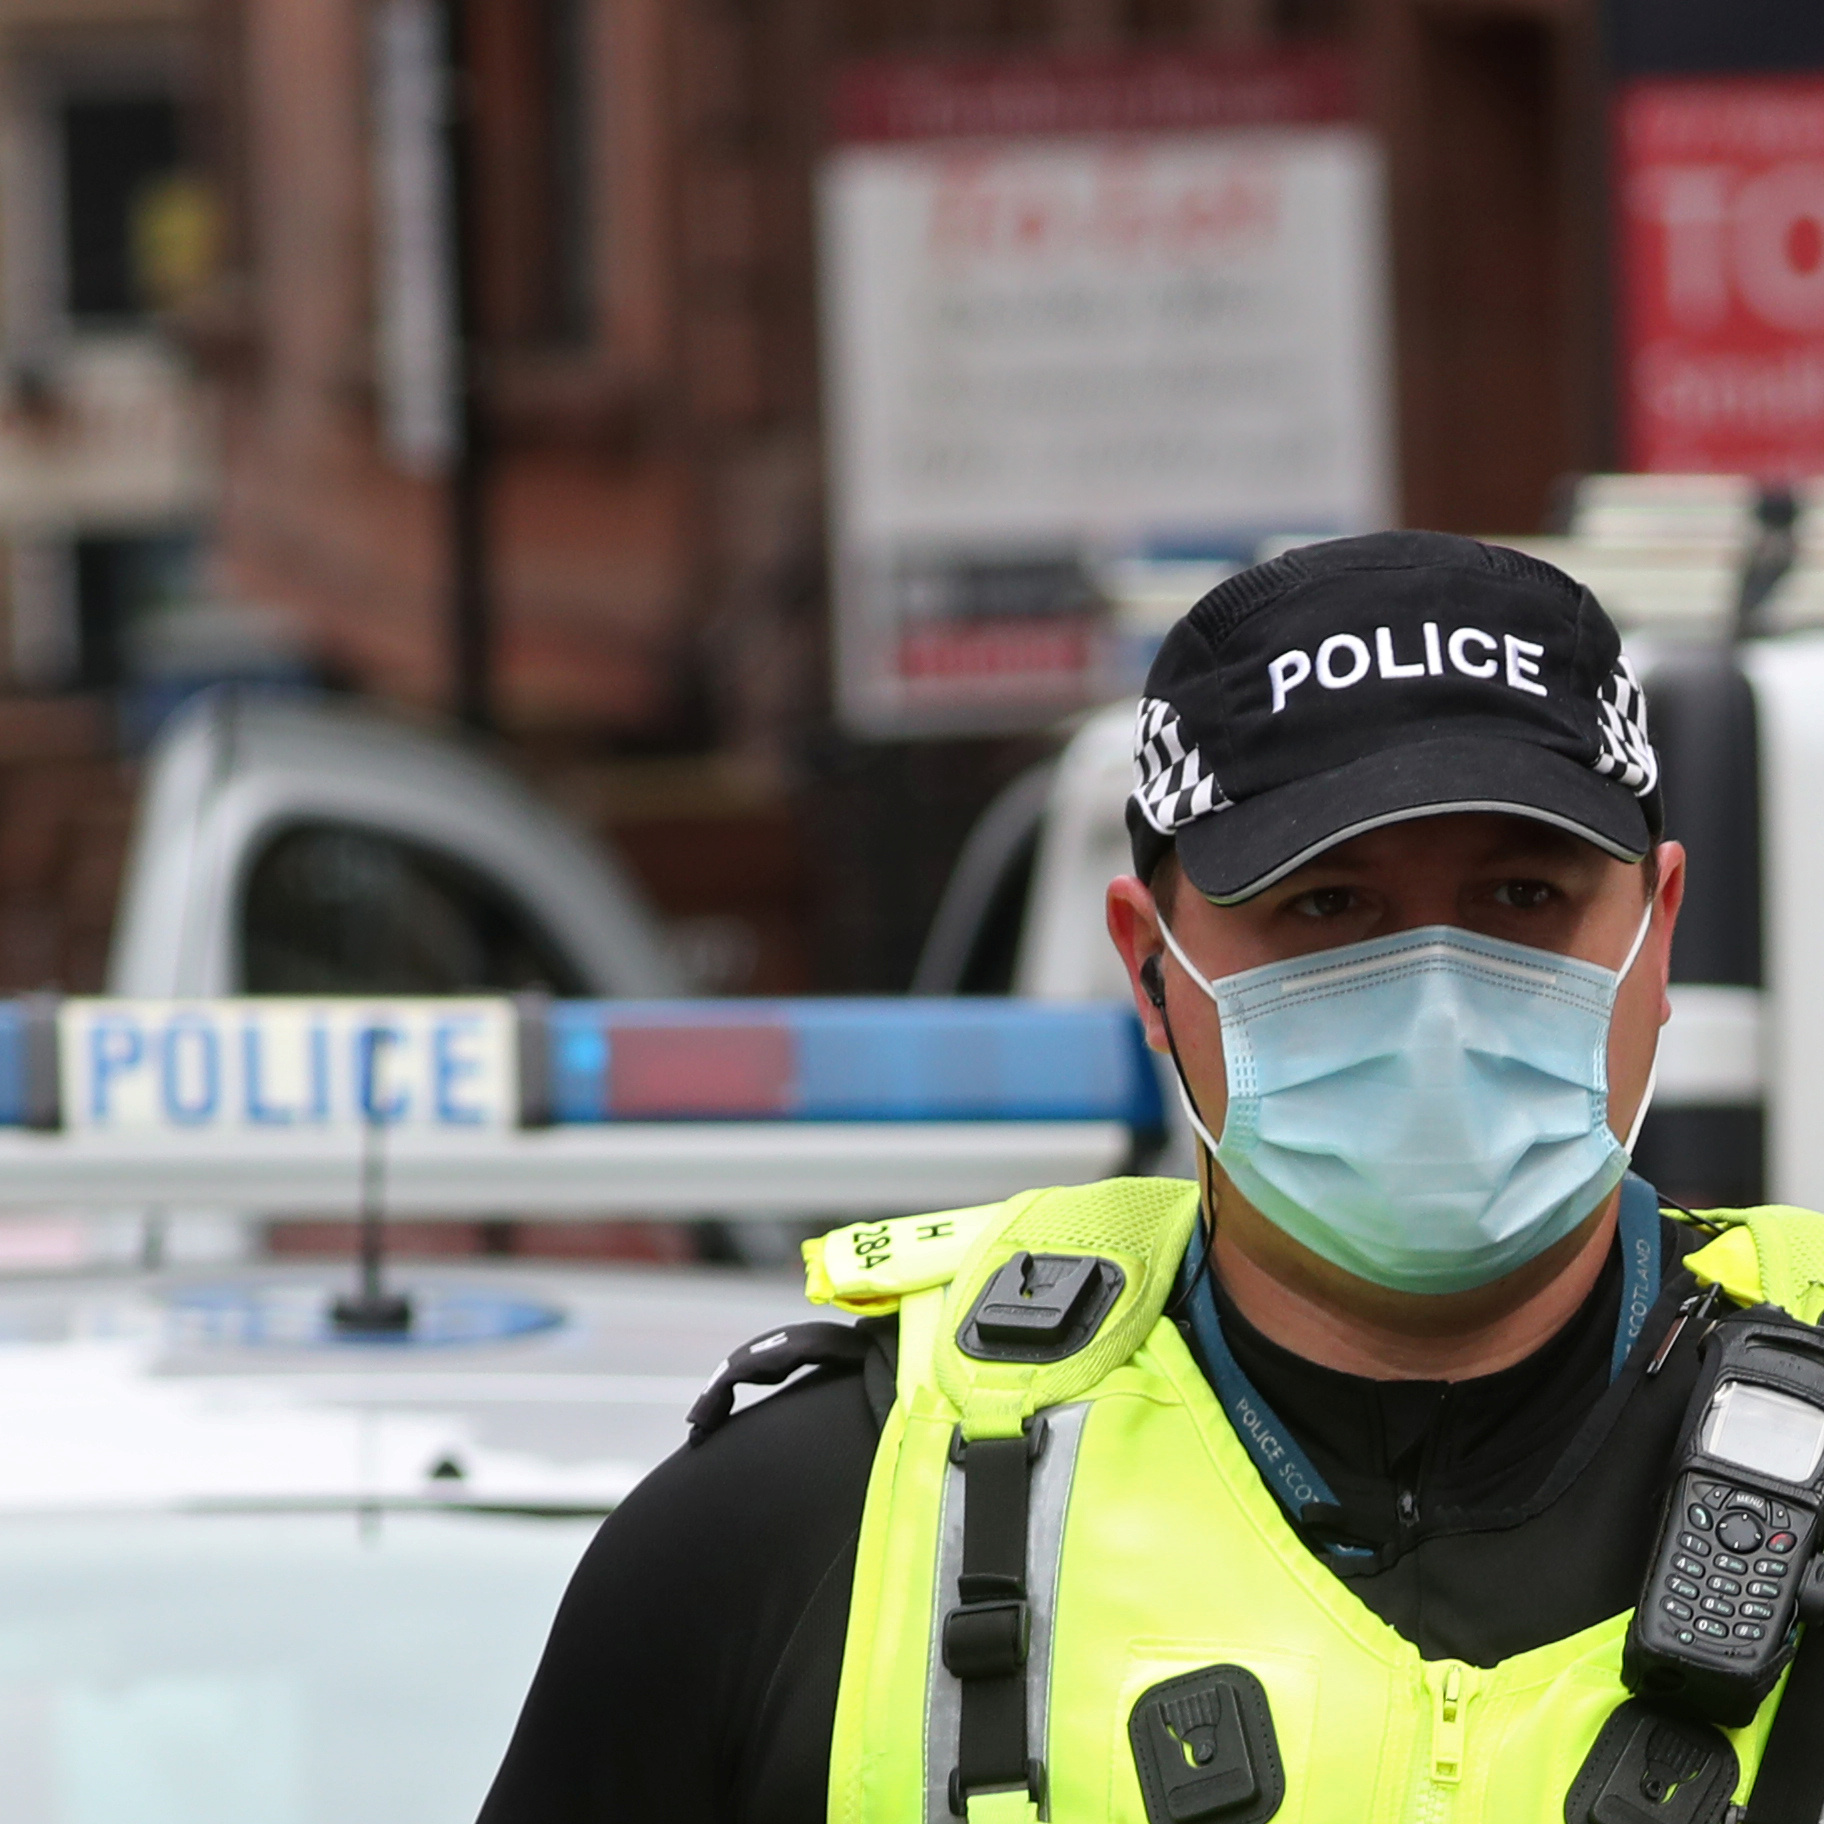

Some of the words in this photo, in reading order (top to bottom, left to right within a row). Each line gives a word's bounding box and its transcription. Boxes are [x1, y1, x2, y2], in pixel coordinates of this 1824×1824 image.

[1268, 621, 1548, 714] POLICE
[88, 1013, 490, 1124] POLICE
[853, 1225, 892, 1269] 284
[1628, 1238, 1651, 1338] SCOTLAND
[1236, 1398, 1286, 1463] POLICE
[1279, 1461, 1320, 1503] SCO
[1736, 1494, 1764, 1509] MENU
